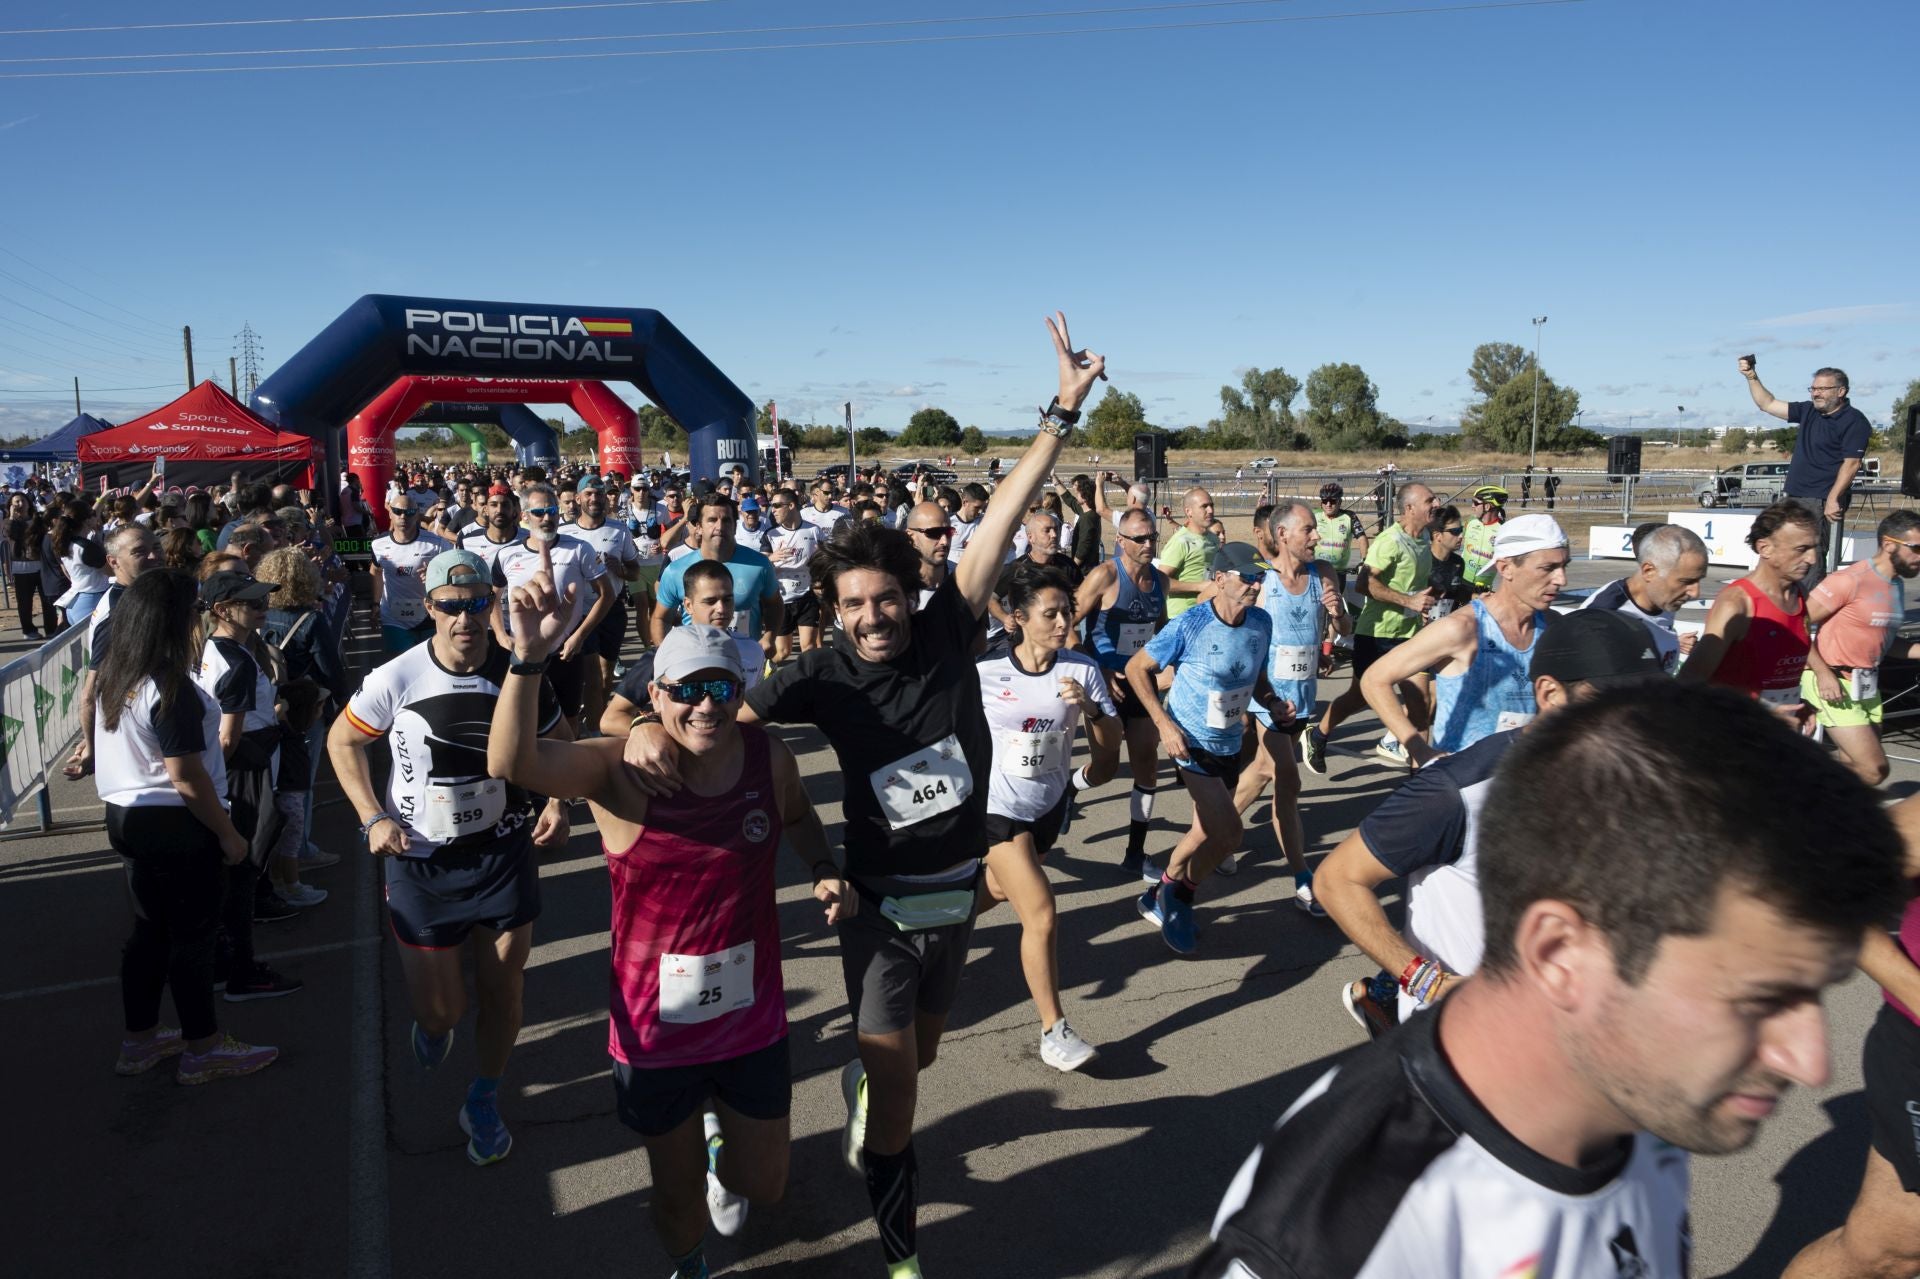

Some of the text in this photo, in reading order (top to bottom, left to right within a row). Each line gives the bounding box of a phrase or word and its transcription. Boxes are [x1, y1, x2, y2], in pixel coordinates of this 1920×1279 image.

[407, 333, 633, 362] NACIONAL
[178, 412, 228, 424] Sports
[171, 423, 253, 436] Santander
[91, 445, 190, 455] Sports Santander
[206, 444, 237, 454] Sports
[716, 439, 749, 460] RUTA
[1704, 520, 1715, 540] 1
[1622, 533, 1632, 551] 2
[1291, 663, 1308, 672] 136
[1021, 754, 1045, 767] 367
[912, 779, 948, 805] 464
[452, 808, 484, 825] 359
[698, 986, 722, 1007] 25
